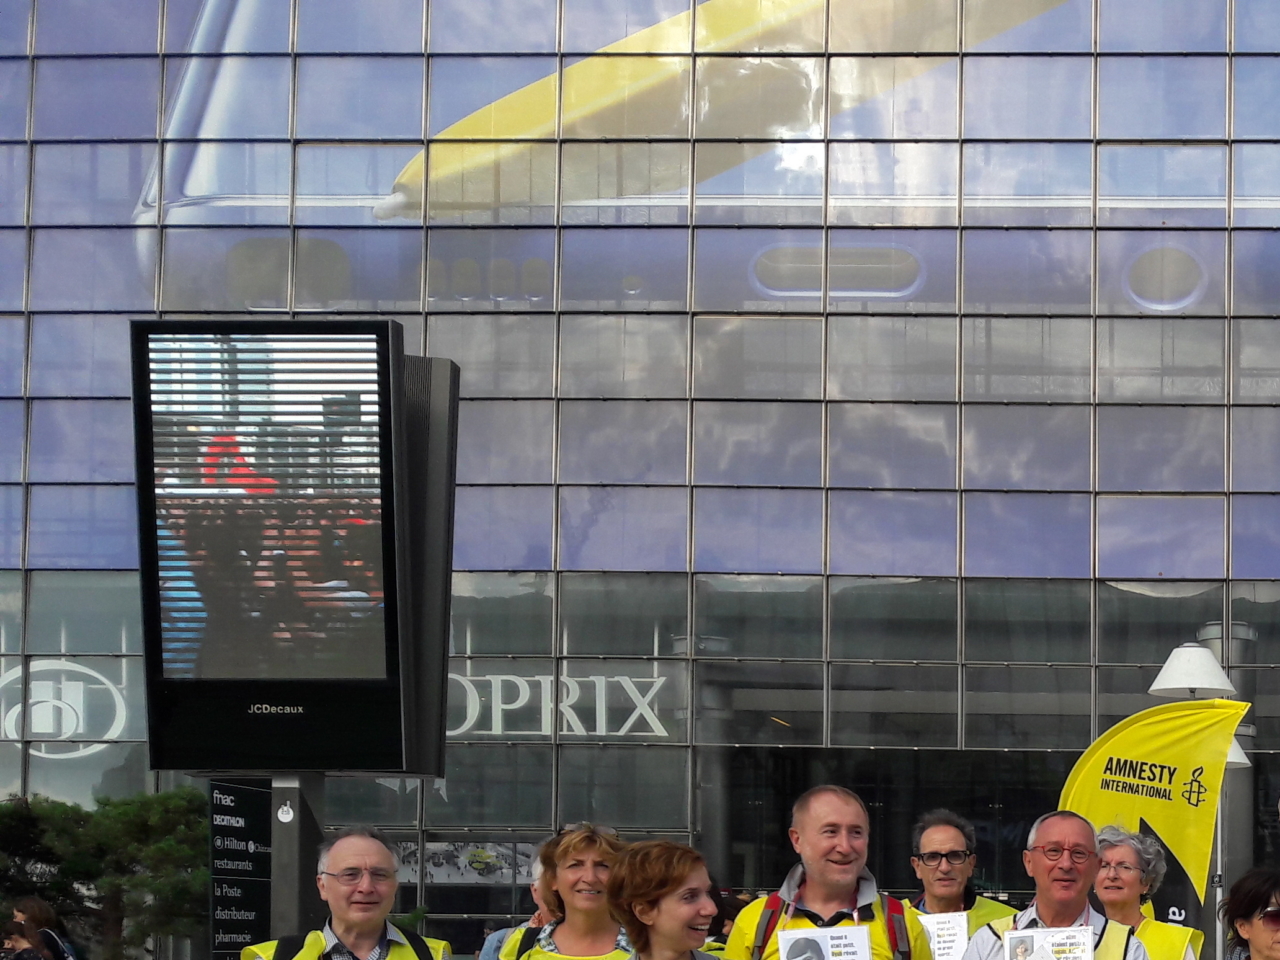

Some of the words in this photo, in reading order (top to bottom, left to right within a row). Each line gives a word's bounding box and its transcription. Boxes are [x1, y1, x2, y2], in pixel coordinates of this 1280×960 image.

[247, 704, 304, 714] JCDecaux
[1103, 756, 1177, 786] AMNESTY
[1100, 777, 1173, 801] INTERNATIONAL
[213, 789, 235, 807] fnac
[213, 814, 245, 828] DECATHLON
[224, 837, 246, 850] Hilton
[214, 858, 253, 871] restaurants
[214, 882, 221, 896] la
[222, 883, 242, 897] Poste
[214, 906, 256, 920] distributeur
[215, 929, 252, 946] pharmacie
